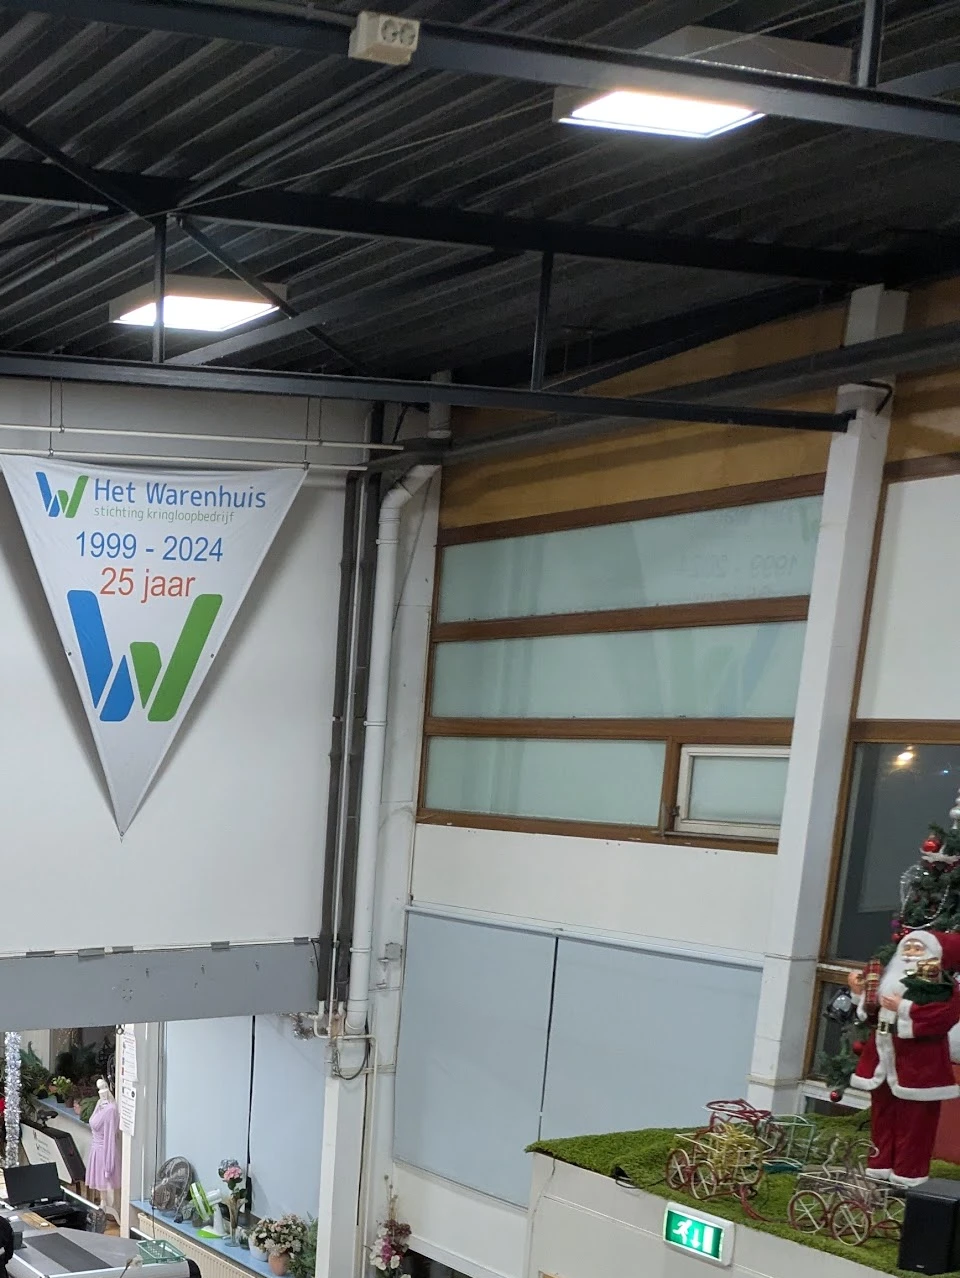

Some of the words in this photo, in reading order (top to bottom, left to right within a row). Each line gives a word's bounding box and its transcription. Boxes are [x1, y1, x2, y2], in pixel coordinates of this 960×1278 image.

[94, 478, 136, 502] Het
[146, 482, 266, 508] Warenhuis
[94, 506, 143, 522] stichting
[147, 508, 234, 524] kringloopbedrijf
[76, 531, 137, 559] 1999
[162, 536, 223, 562] 2024
[99, 567, 134, 596] 25
[141, 568, 195, 603] jaar
